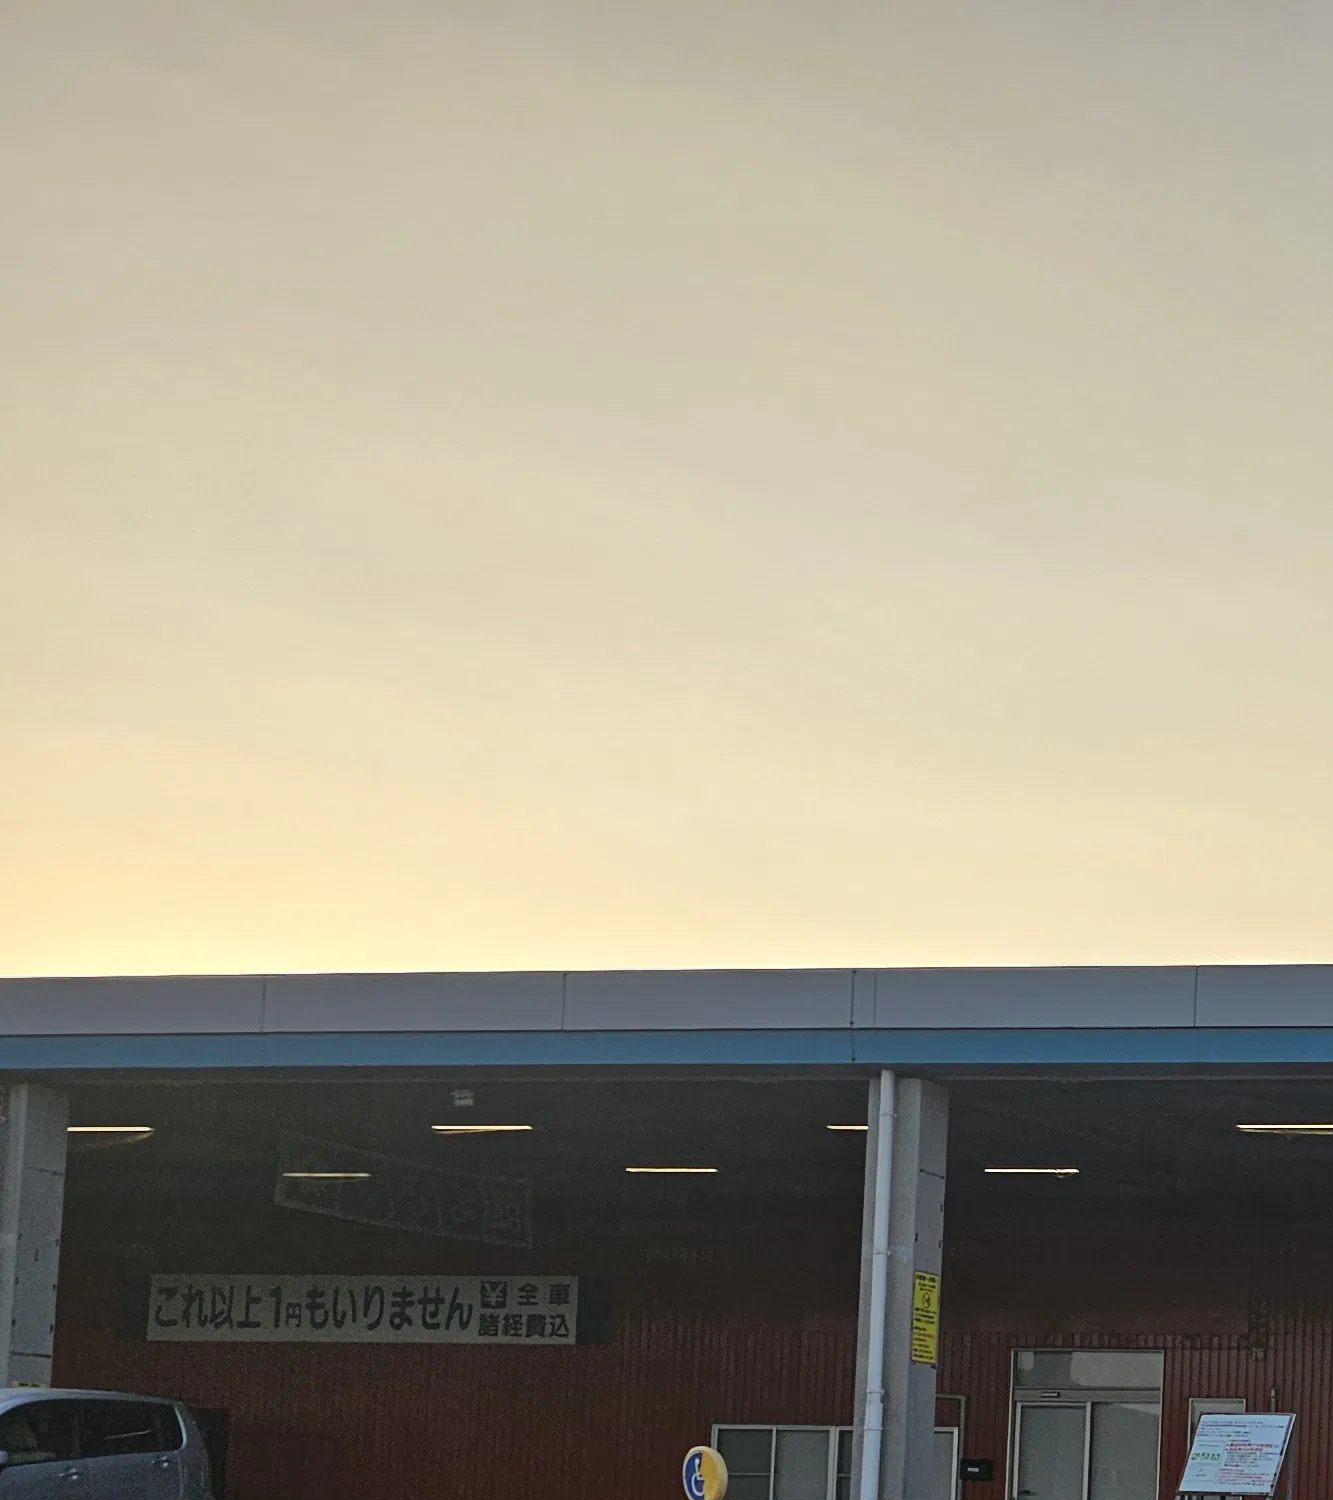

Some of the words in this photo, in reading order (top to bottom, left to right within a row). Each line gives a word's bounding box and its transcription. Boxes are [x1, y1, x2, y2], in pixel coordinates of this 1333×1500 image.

[153, 1285, 473, 1331] これ以上1円もいりません
